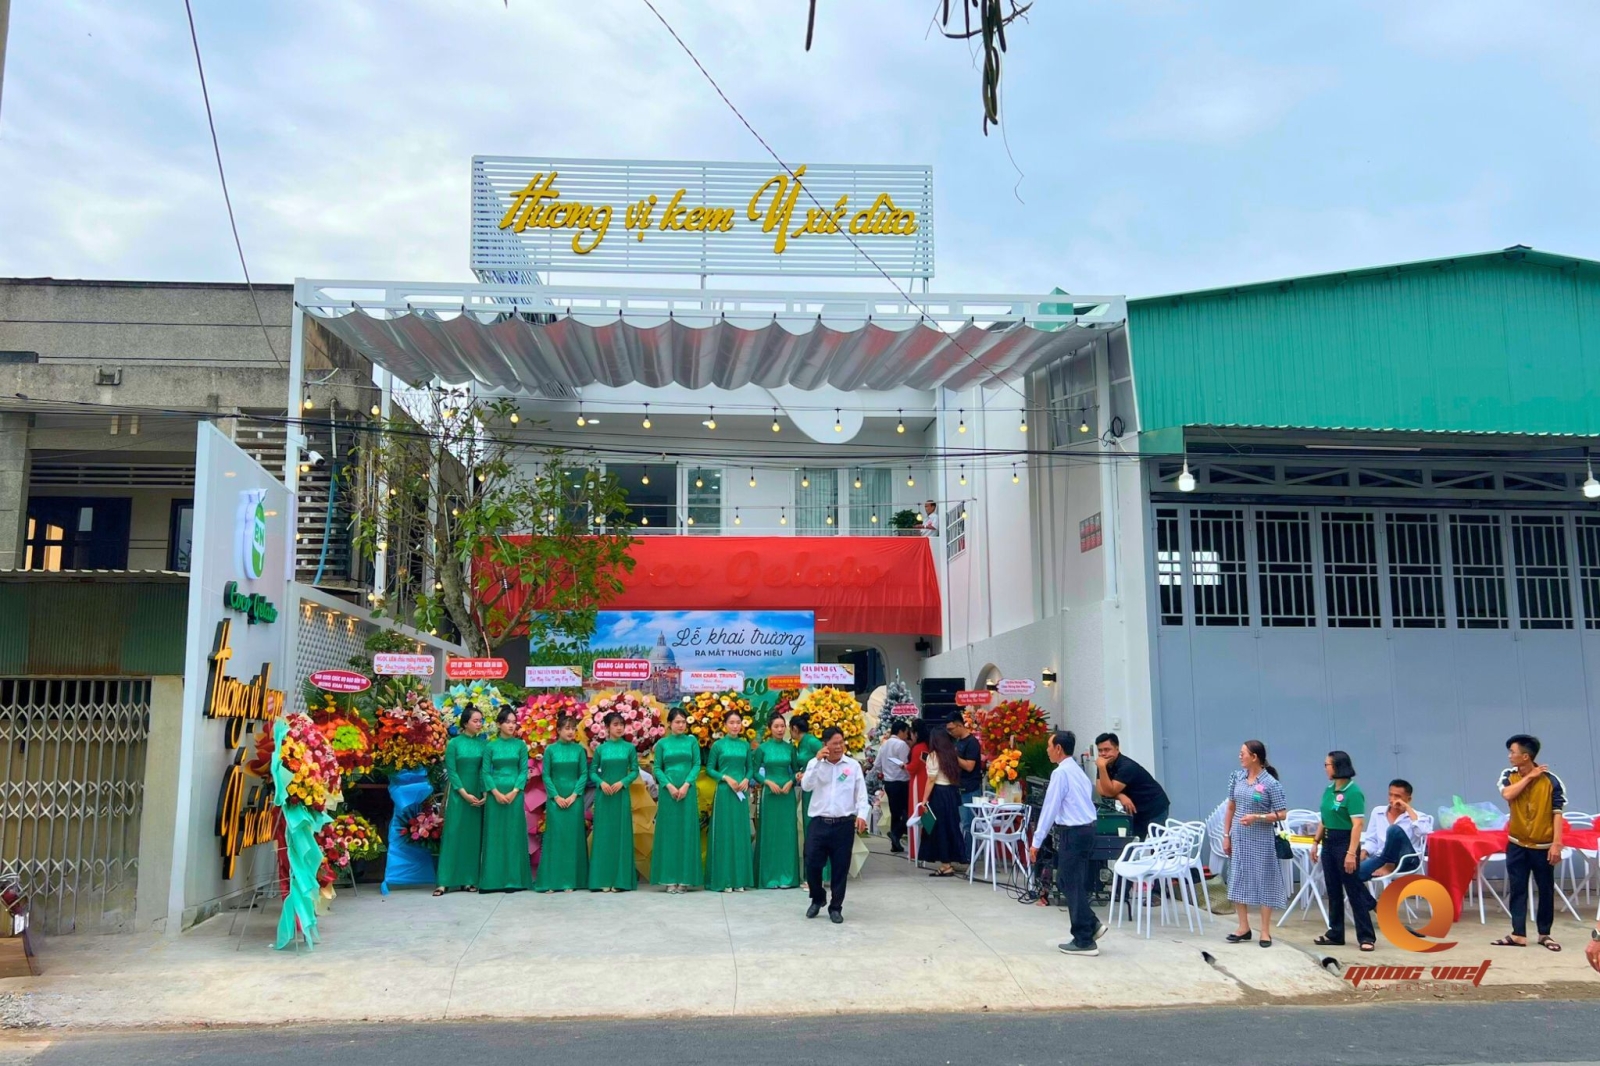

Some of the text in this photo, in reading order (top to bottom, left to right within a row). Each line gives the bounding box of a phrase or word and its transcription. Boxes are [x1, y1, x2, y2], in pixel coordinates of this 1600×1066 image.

[499, 172, 613, 255] Hương
[624, 195, 657, 243] vị
[659, 189, 734, 232] kem
[849, 193, 919, 236] dừa
[672, 627, 806, 655] Lễ khai trương
[614, 661, 624, 669] CÁO
